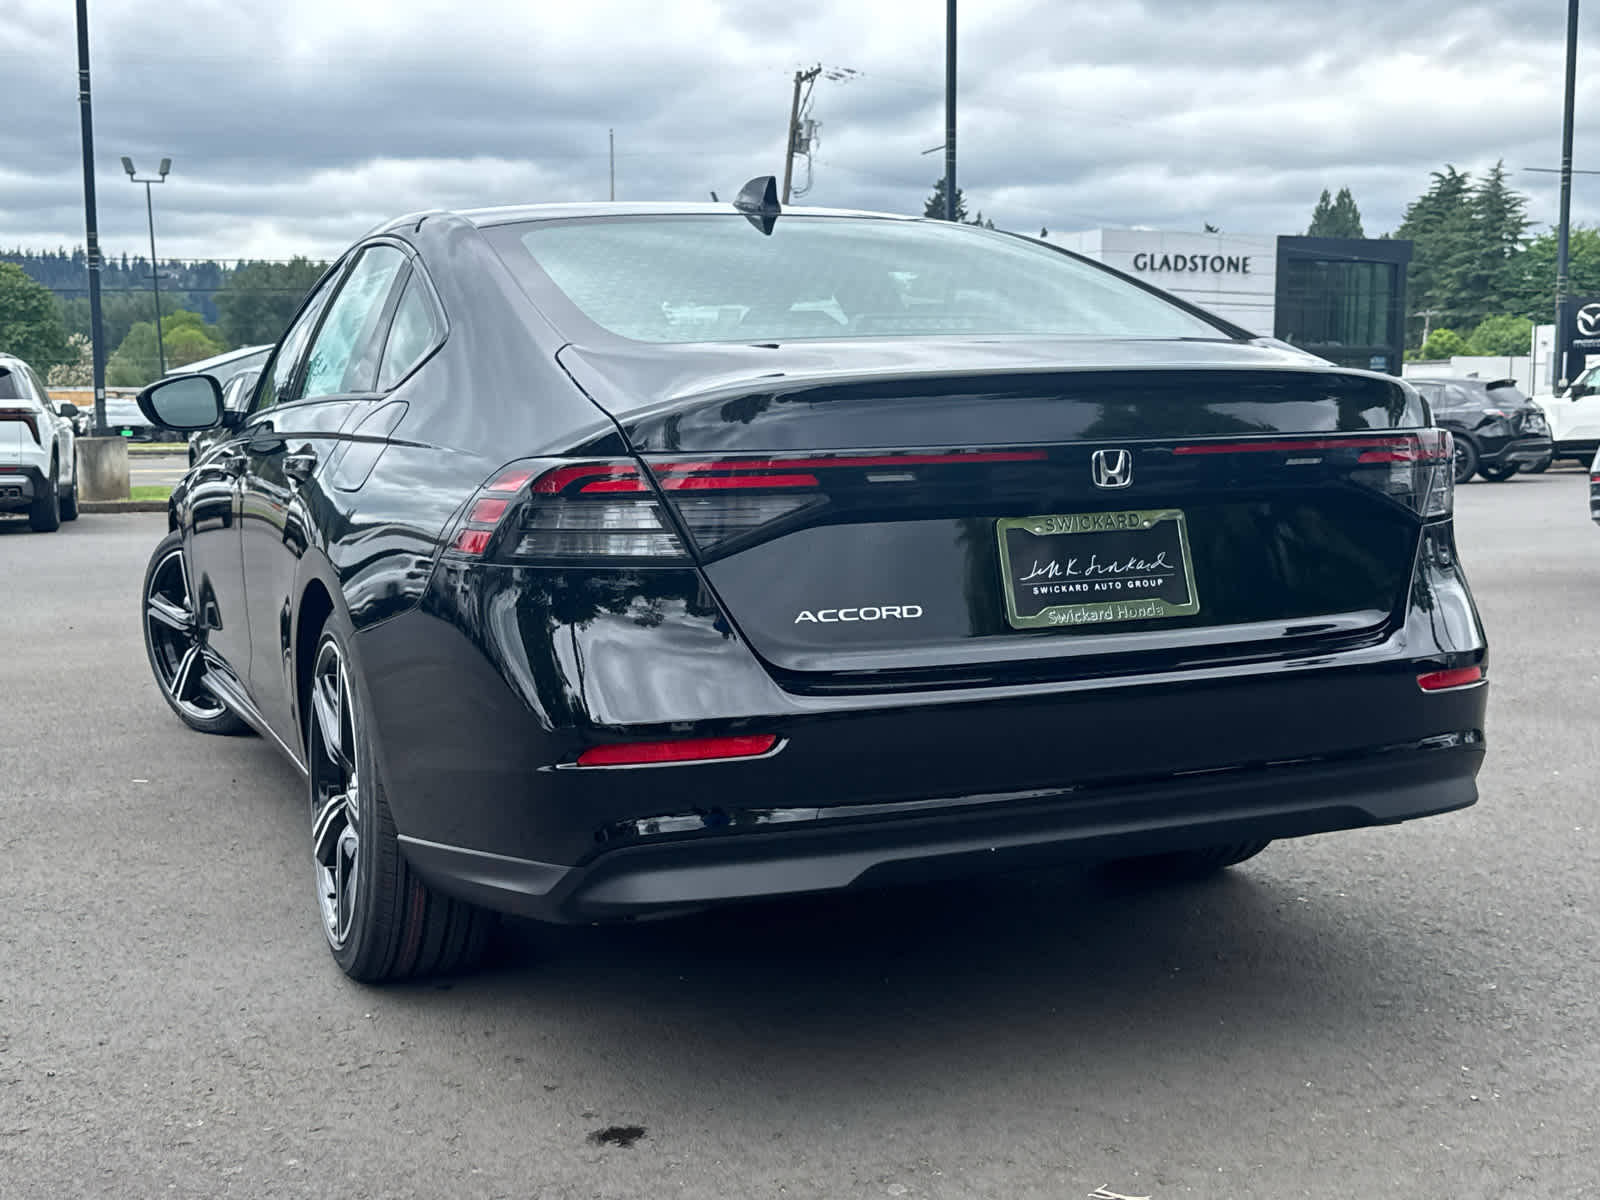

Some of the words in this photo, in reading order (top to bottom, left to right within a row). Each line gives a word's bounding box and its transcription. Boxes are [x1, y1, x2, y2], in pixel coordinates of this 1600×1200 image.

[1133, 253, 1252, 275] GLADSTONE
[1046, 513, 1140, 533] SWICKARD
[1032, 583, 1089, 595] SWICKARD
[1094, 581, 1122, 591] AUTO
[1127, 578, 1164, 589] GROUP
[794, 605, 923, 624] ACCORD
[1048, 606, 1113, 625] Swickard
[1117, 602, 1164, 619] Honda
